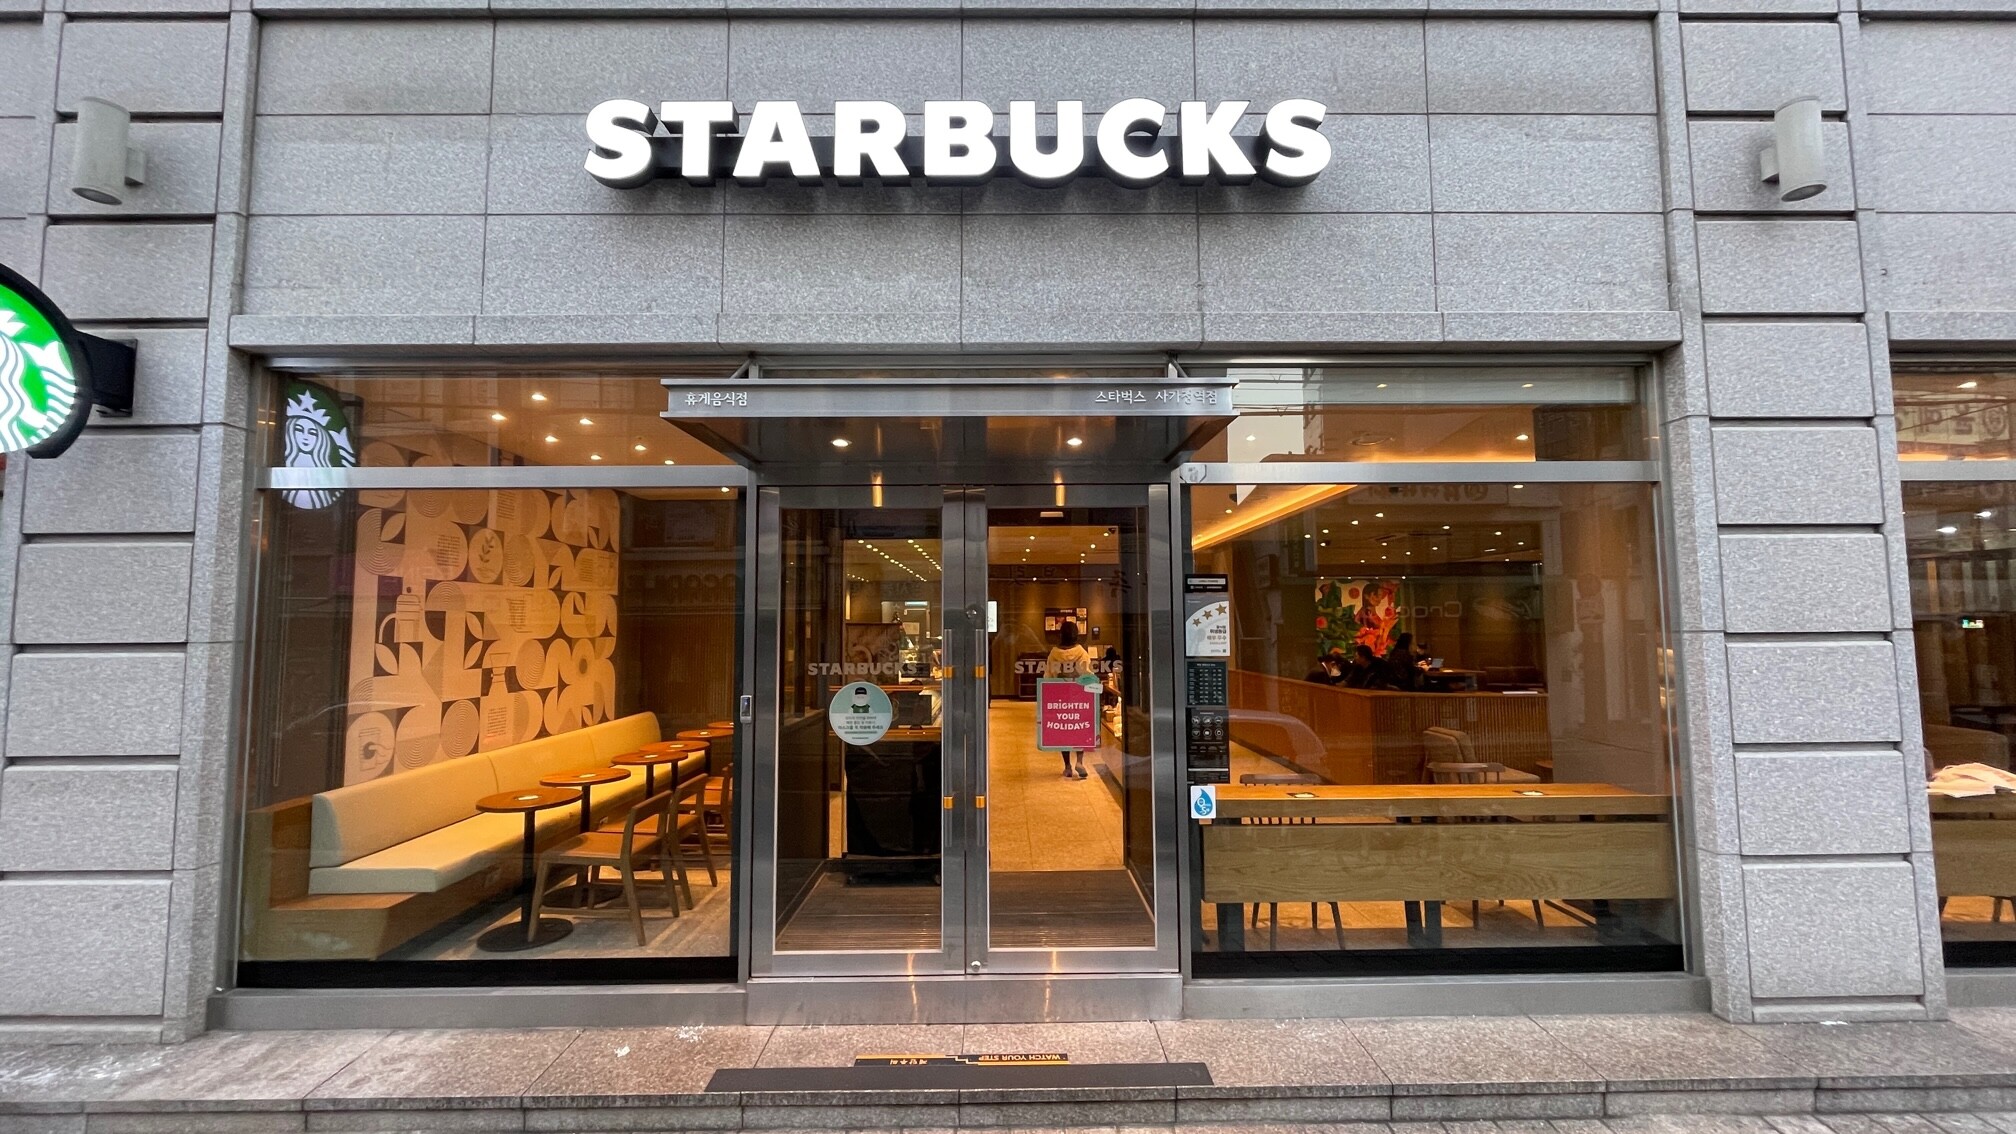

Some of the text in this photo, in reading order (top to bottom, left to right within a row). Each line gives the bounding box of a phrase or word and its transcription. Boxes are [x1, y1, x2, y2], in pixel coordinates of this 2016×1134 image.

[583, 97, 1333, 181] STARBUCKS
[684, 391, 748, 407] 휴게음식점
[1095, 389, 1218, 405] 스타벅스 사가정역점
[807, 662, 918, 676] STARBUCKS
[1014, 660, 1124, 675] STARBUCKS
[1047, 699, 1090, 710] BRIGHTEN
[1056, 713, 1080, 721] YOUR
[1046, 721, 1091, 731] HOLIDAYS
